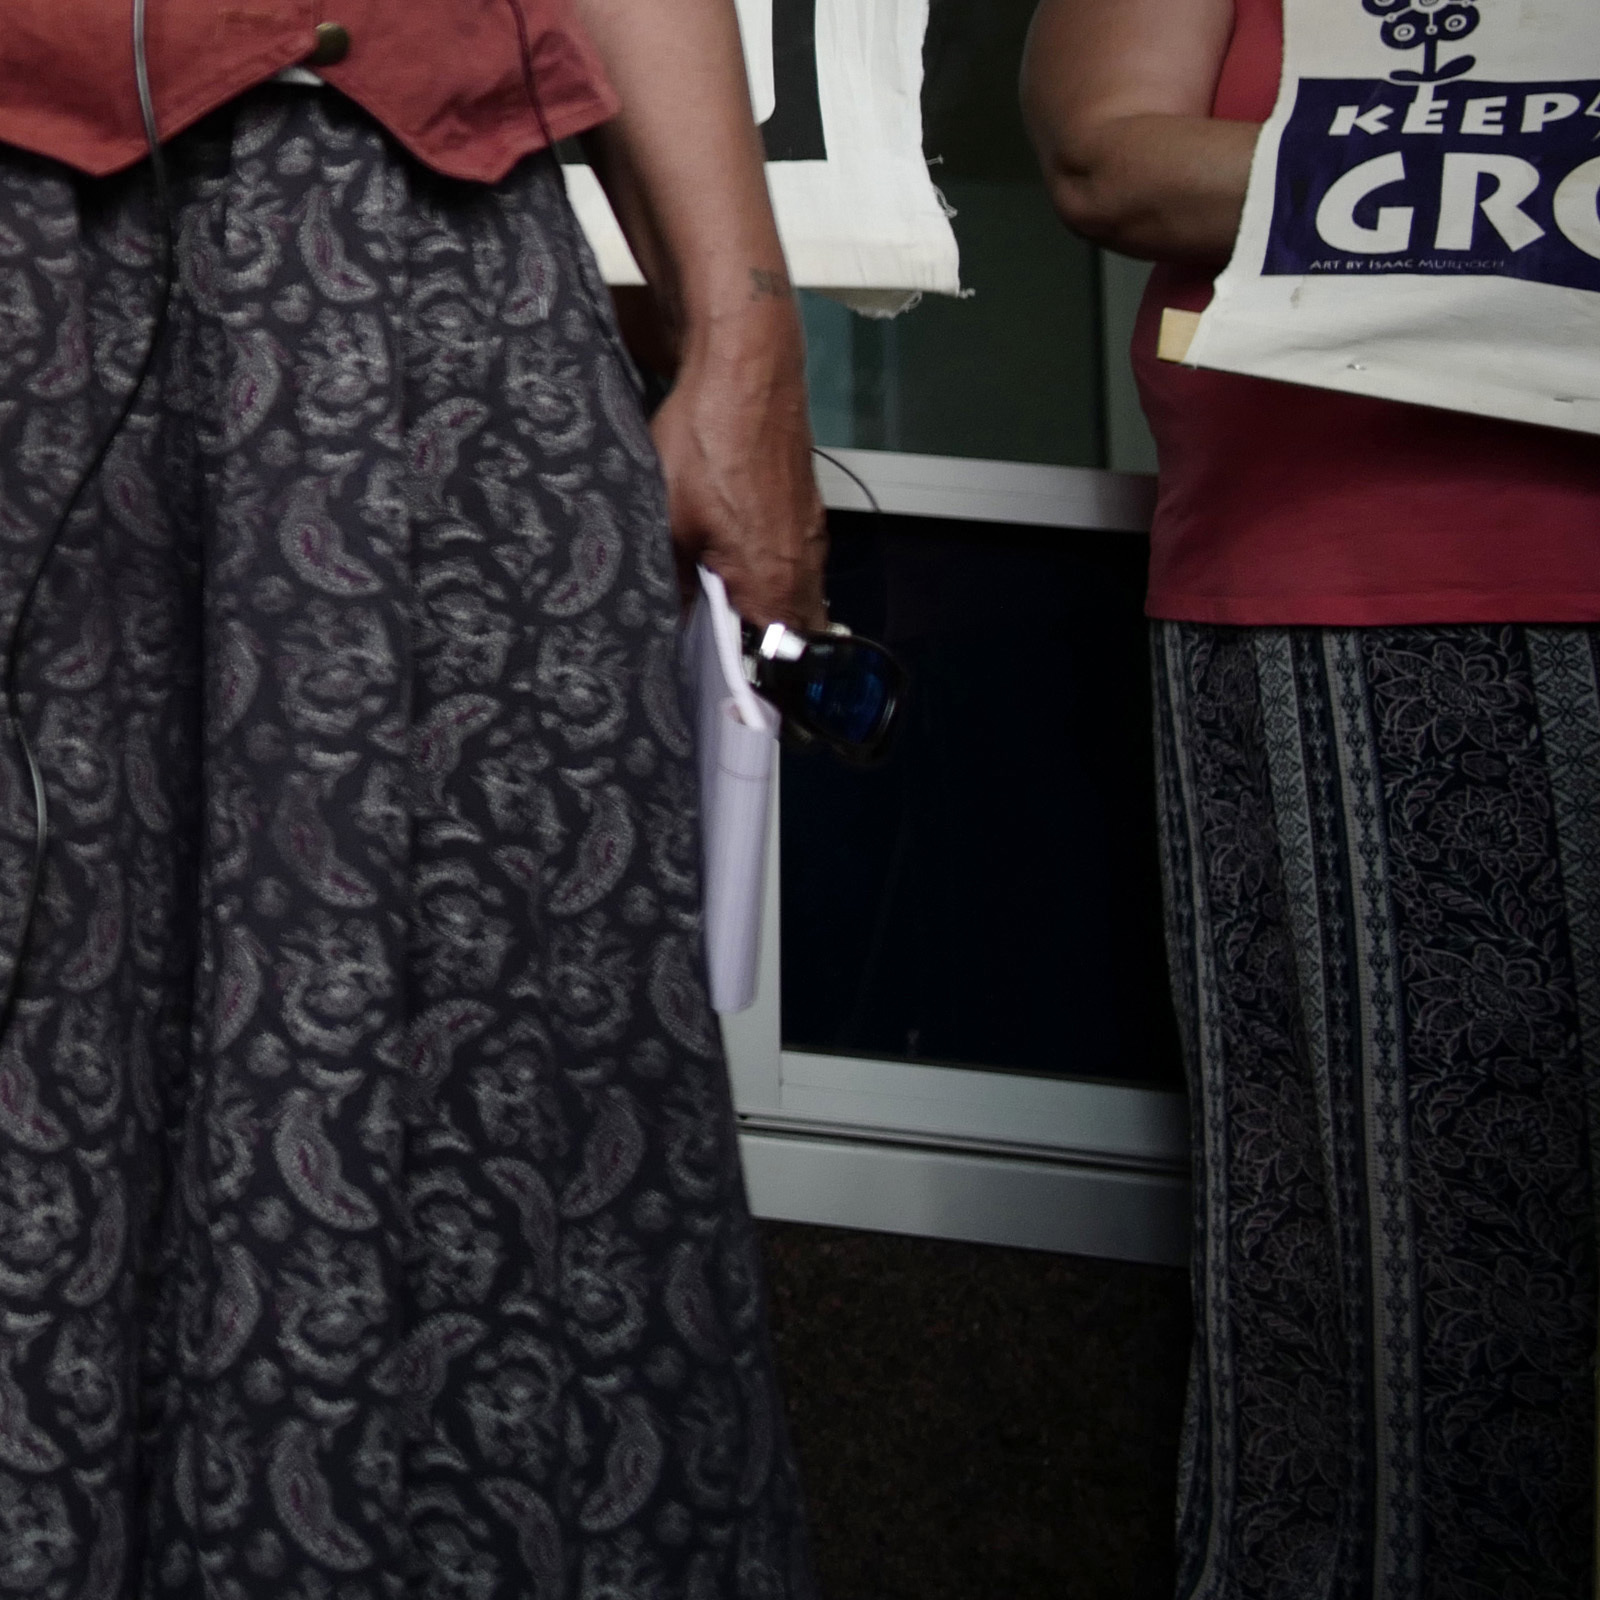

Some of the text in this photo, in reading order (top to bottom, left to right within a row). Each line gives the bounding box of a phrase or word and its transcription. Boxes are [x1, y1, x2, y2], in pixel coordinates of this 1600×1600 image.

[1328, 92, 1580, 136] KEEP
[1309, 259, 1340, 271] ART
[1345, 259, 1364, 270] BY
